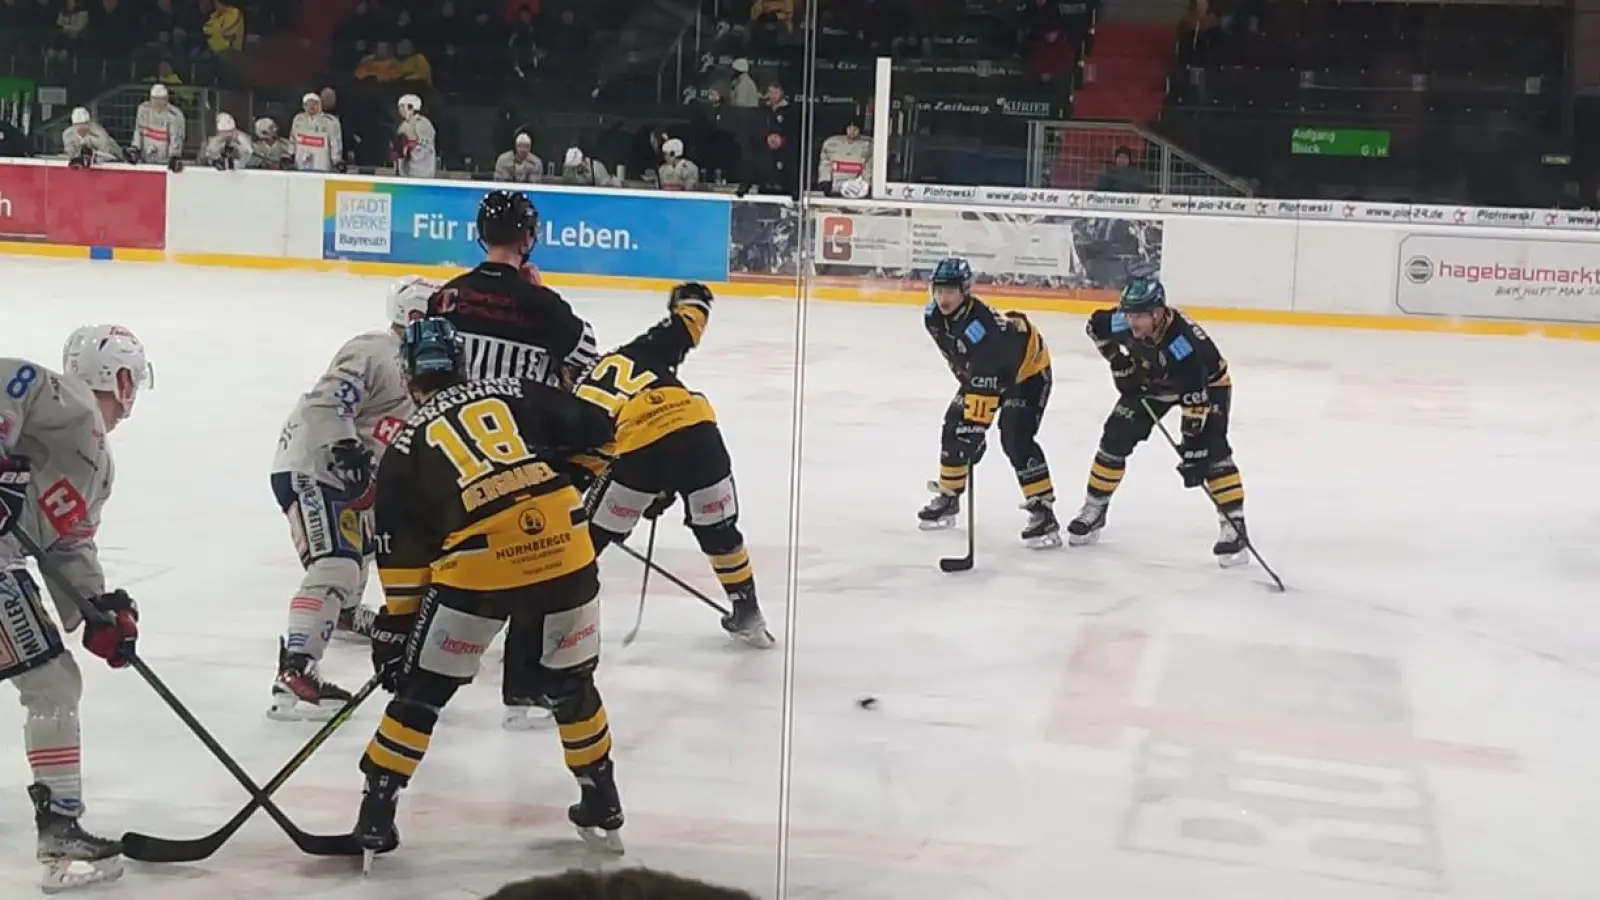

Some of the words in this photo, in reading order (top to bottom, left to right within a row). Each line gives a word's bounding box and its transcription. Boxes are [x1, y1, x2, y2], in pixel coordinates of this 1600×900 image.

[340, 198, 388, 213] STADT
[339, 215, 389, 231] WERKE
[413, 212, 458, 241] Für
[546, 220, 639, 250] Leben.
[339, 233, 387, 248] Bayreuth
[1438, 260, 1600, 286] hagebaumarkt
[575, 354, 659, 417] 12
[973, 398, 987, 418] 11
[425, 397, 537, 490] 18
[373, 530, 392, 554] nt
